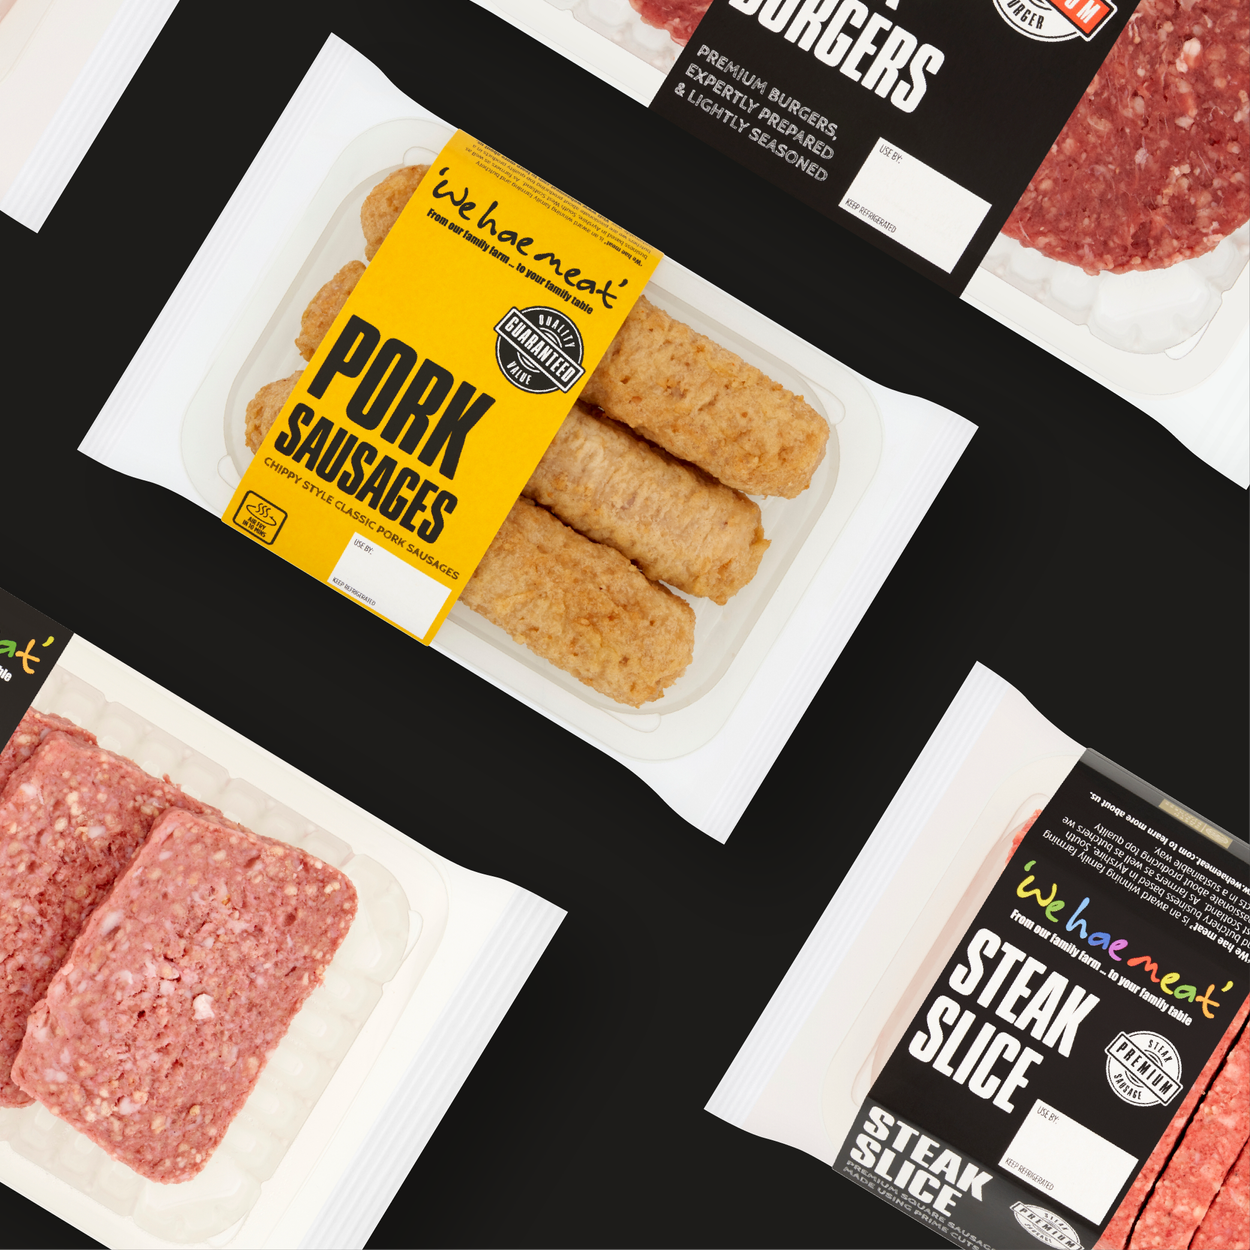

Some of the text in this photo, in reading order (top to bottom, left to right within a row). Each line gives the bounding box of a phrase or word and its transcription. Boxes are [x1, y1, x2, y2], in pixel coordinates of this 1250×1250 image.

[685, 62, 835, 160] EXPERTLY PREPARED
[696, 44, 838, 141] PREMIUM BURGERS,
[674, 82, 829, 182] & LIGHTLY SEASONED
[879, 144, 894, 158] USE
[476, 200, 534, 257] hae
[504, 316, 576, 383] GUARANTEED
[538, 314, 575, 348] QUALITY
[306, 314, 496, 481] PORK
[506, 360, 532, 385] VALUE
[273, 402, 459, 544] SAUSAGES
[1065, 896, 1129, 962] hae
[948, 928, 1101, 1058] STEAK
[908, 995, 1044, 1114] SLICE
[1113, 1073, 1142, 1100] SAUSAGE
[1115, 1041, 1173, 1095] PREMIUM
[1148, 1039, 1173, 1063] STEAK
[849, 1133, 963, 1218] SLICE
[862, 1106, 994, 1202] STEAK
